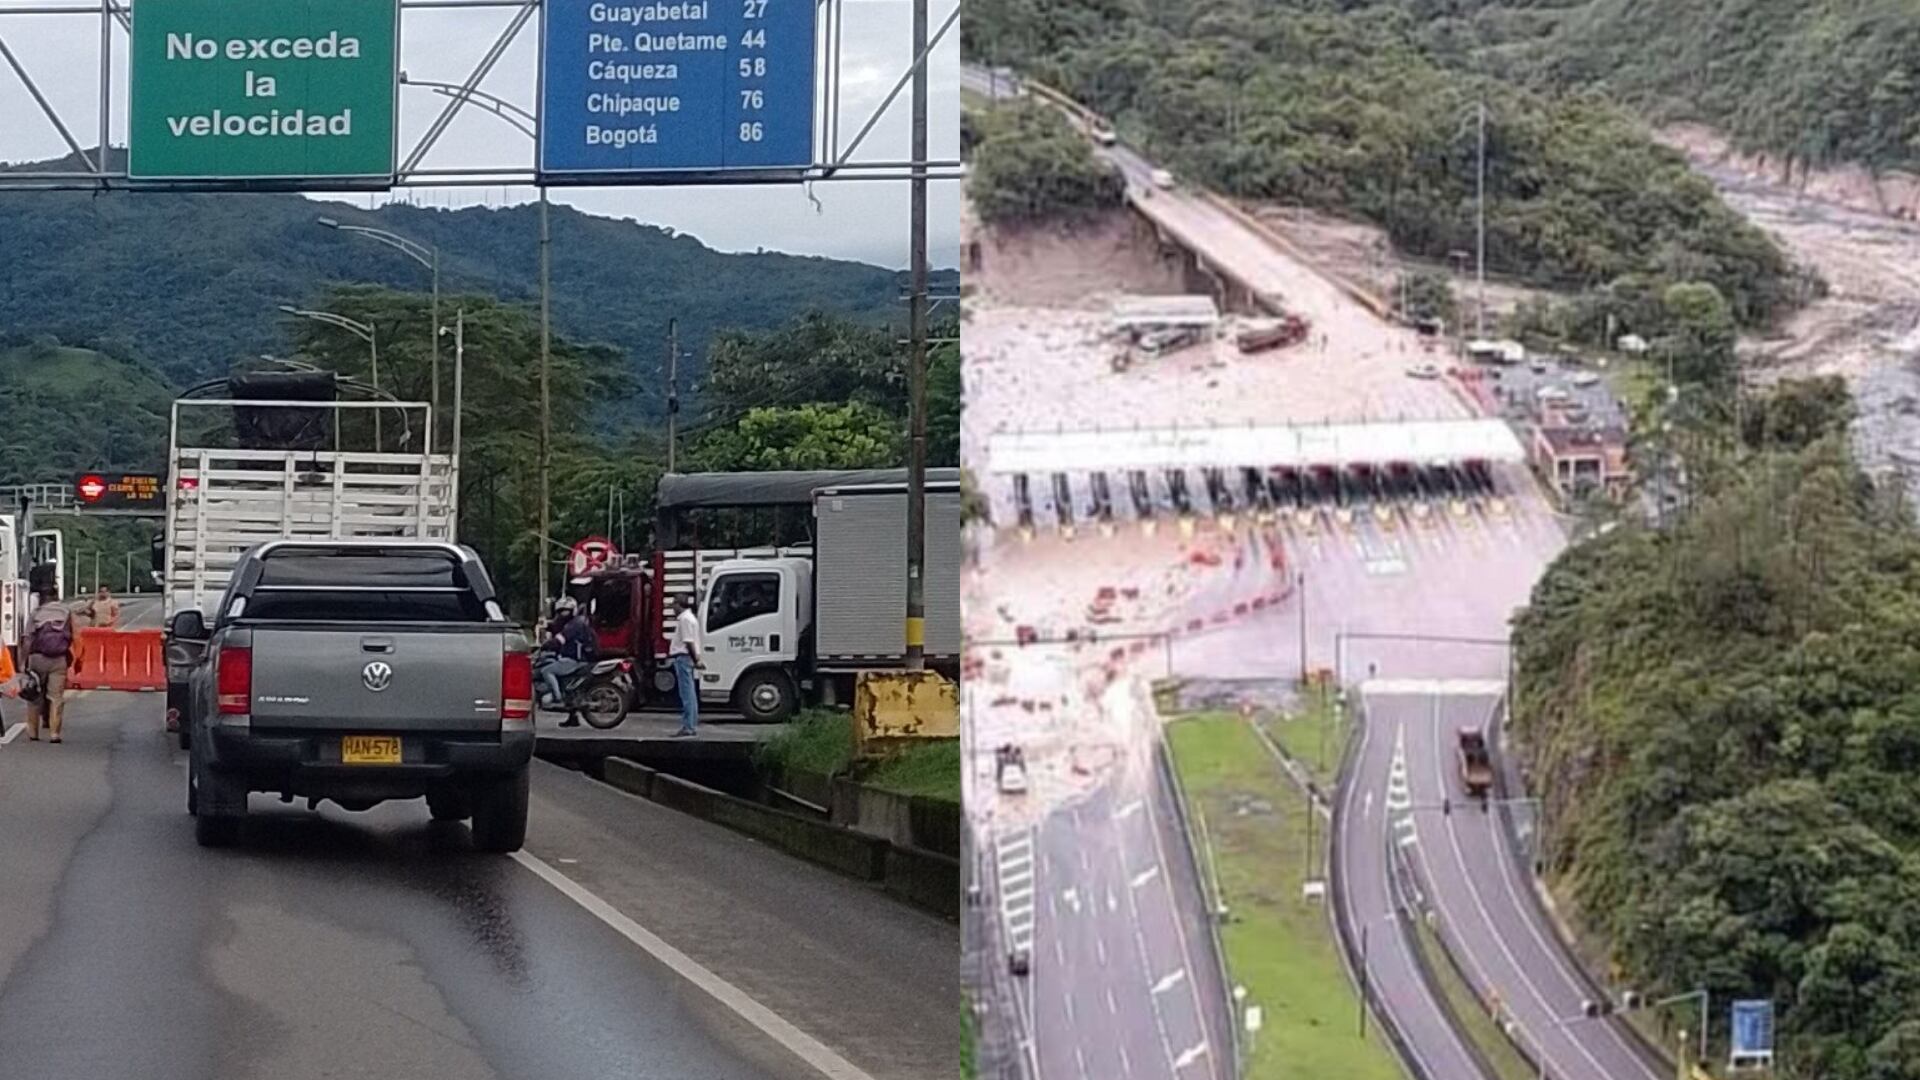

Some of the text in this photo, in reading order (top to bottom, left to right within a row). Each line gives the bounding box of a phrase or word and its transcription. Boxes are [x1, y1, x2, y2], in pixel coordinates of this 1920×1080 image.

[589, 0, 768, 26] Guayabetal 27
[166, 30, 360, 60] No exceda
[588, 29, 766, 53] Pte. Quetame 44
[245, 70, 277, 97] la
[588, 57, 767, 84] Cáqueza 58
[586, 90, 764, 117] Chipaque 76
[166, 109, 352, 137] velocidad
[586, 122, 763, 149] Bogotá 86
